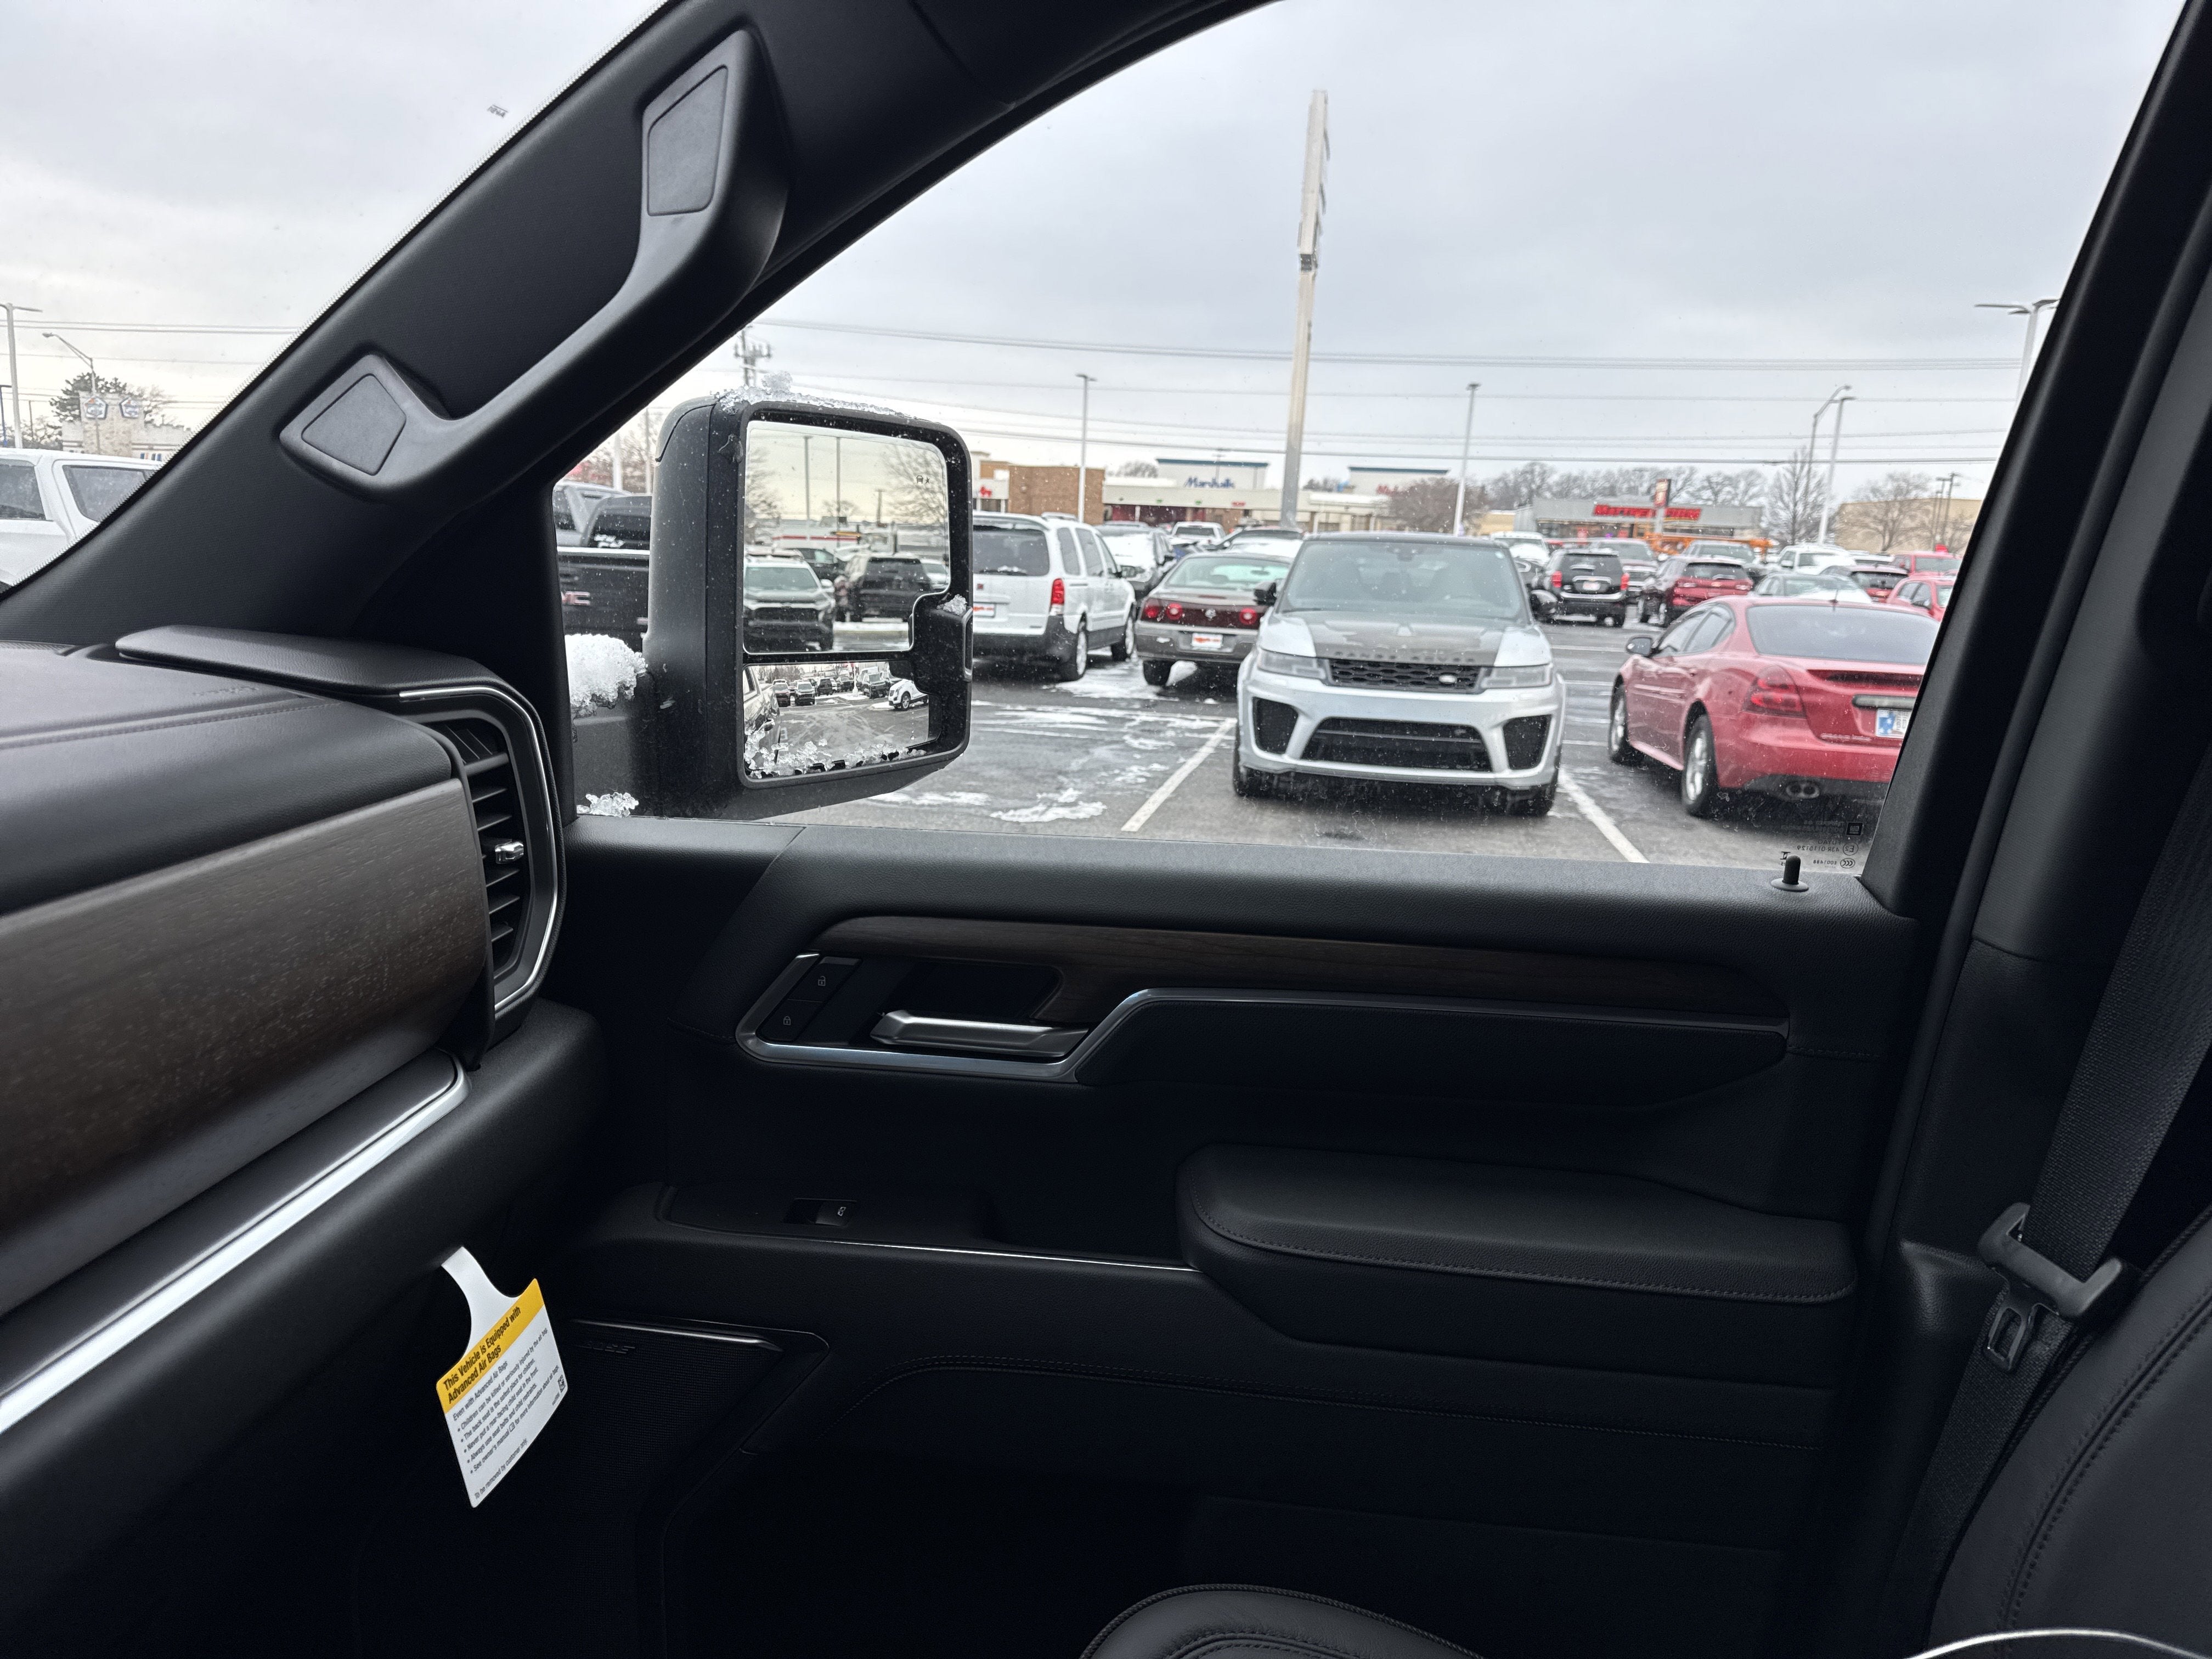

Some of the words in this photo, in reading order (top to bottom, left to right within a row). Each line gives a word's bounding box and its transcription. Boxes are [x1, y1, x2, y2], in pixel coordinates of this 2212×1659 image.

[443, 1373, 459, 1391] This
[458, 1351, 481, 1376] Vehicle
[479, 1345, 487, 1356] is
[485, 1317, 510, 1349] Equipped
[509, 1306, 521, 1323] with
[448, 1367, 479, 1404] Advanced
[478, 1359, 487, 1374] Air
[486, 1344, 501, 1364] Bags
[453, 1407, 465, 1421] Even
[464, 1397, 475, 1410] with
[474, 1375, 493, 1401] Advanced
[498, 1361, 508, 1374] Bags
[460, 1409, 479, 1430] Children
[490, 1383, 501, 1398] killed
[467, 1436, 479, 1451] Never
[470, 1443, 486, 1462] Always
[473, 1460, 482, 1472] See
